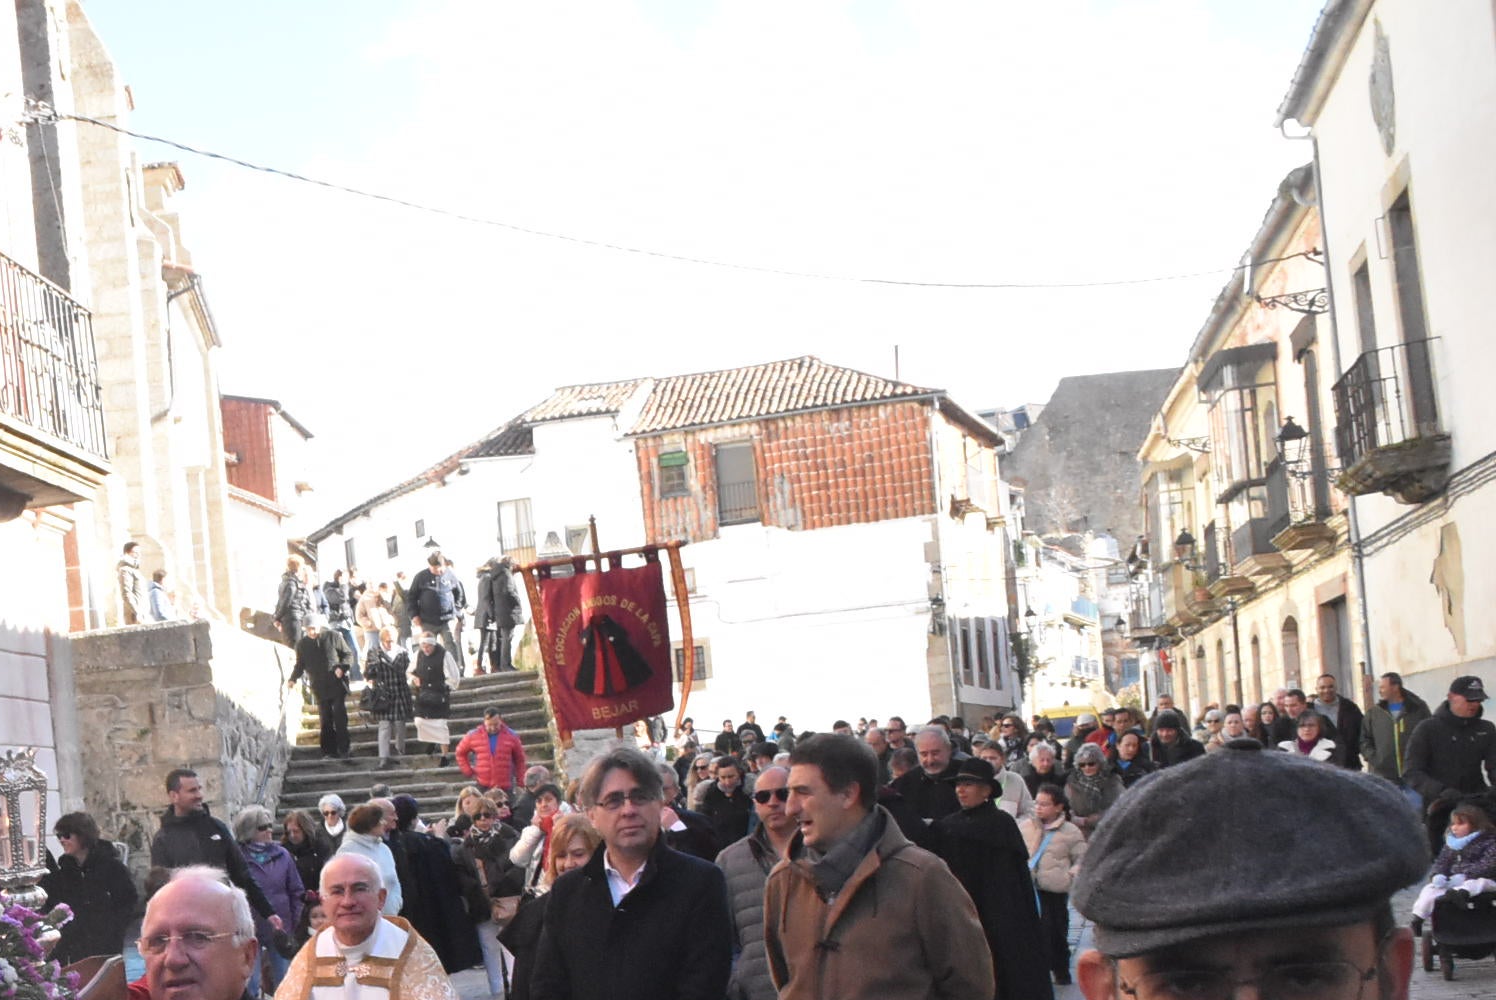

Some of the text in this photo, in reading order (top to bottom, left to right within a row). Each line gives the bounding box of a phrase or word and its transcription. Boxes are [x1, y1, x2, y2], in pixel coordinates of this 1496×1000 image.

[620, 598, 636, 612] DE
[635, 608, 650, 624] LA
[591, 700, 639, 720] BEJAR
